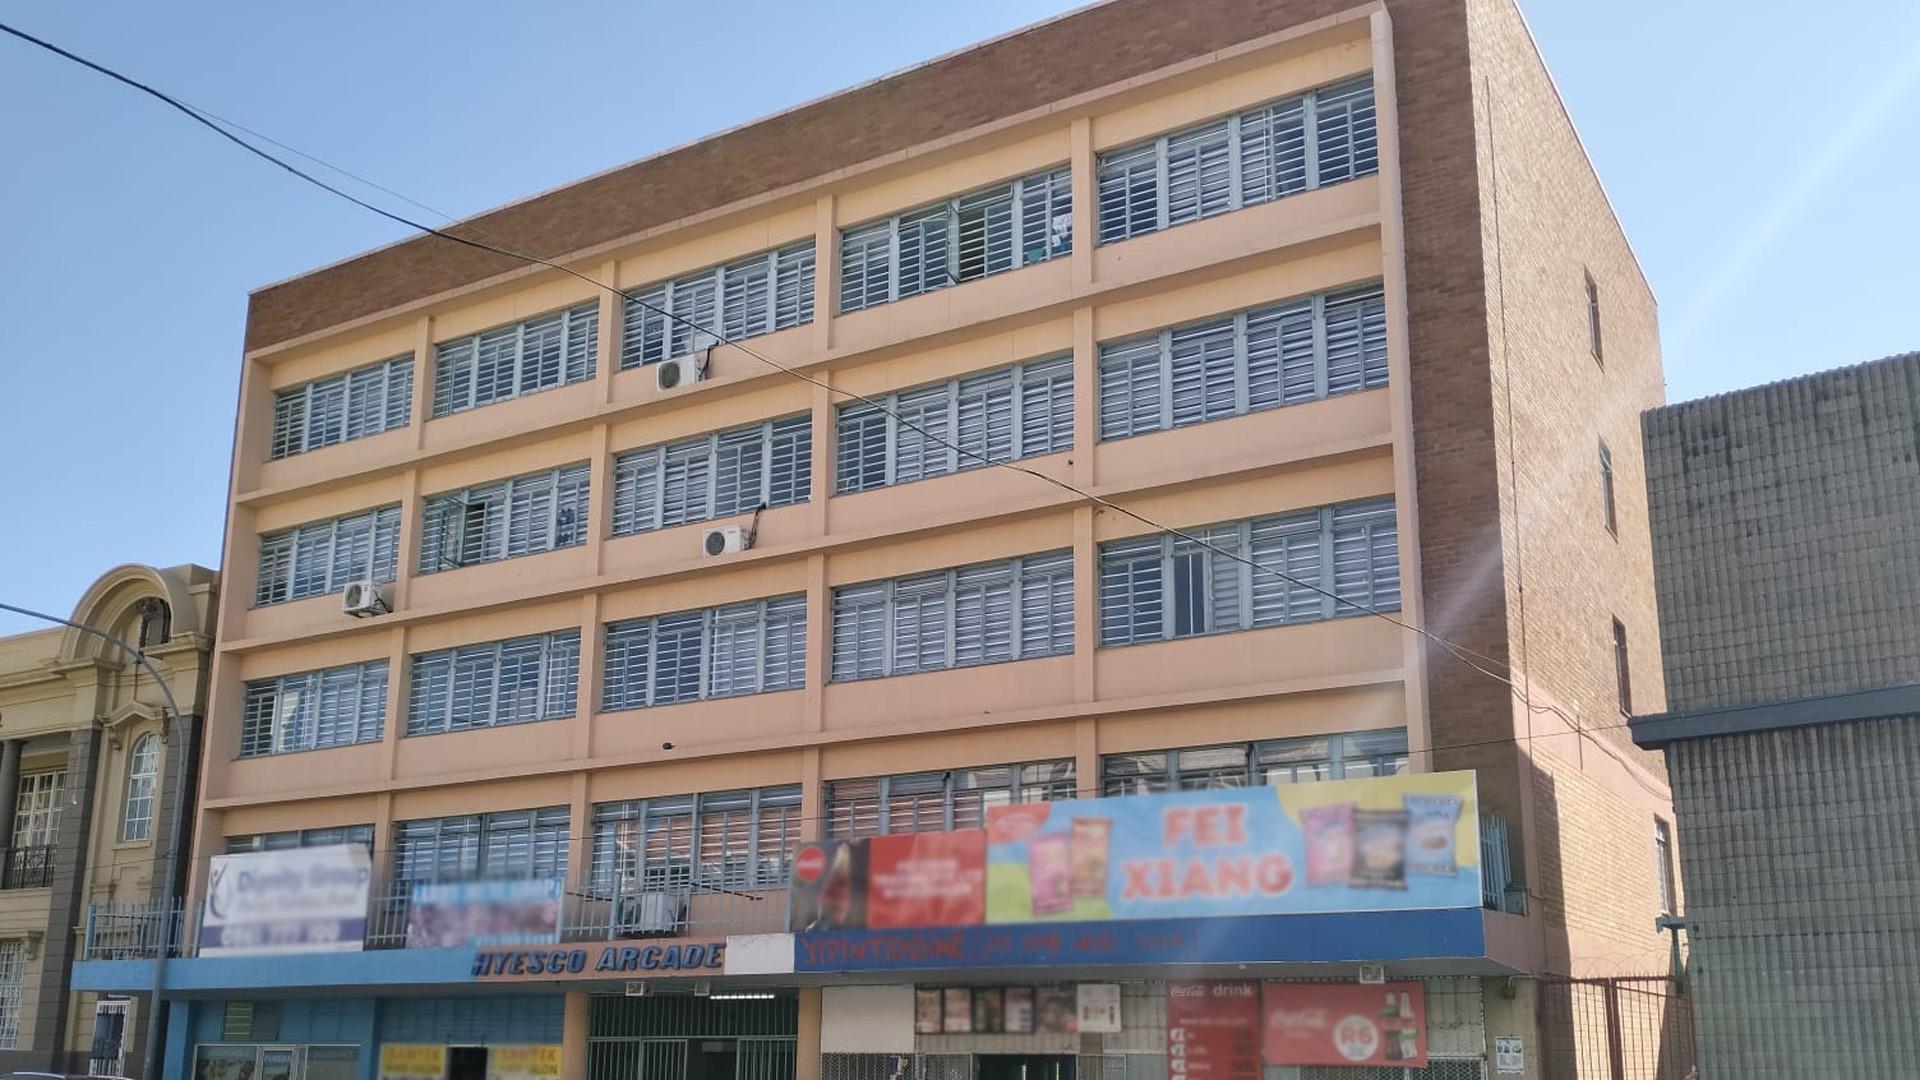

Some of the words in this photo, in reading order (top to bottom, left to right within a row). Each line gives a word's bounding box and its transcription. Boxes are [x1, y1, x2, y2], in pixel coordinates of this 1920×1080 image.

[1164, 805, 1247, 848] FEI
[1122, 854, 1294, 900] XIANG
[472, 950, 586, 976] HYESCO
[595, 943, 726, 971] ARCADE
[1213, 983, 1253, 997] drink
[1340, 1026, 1373, 1045] R6
